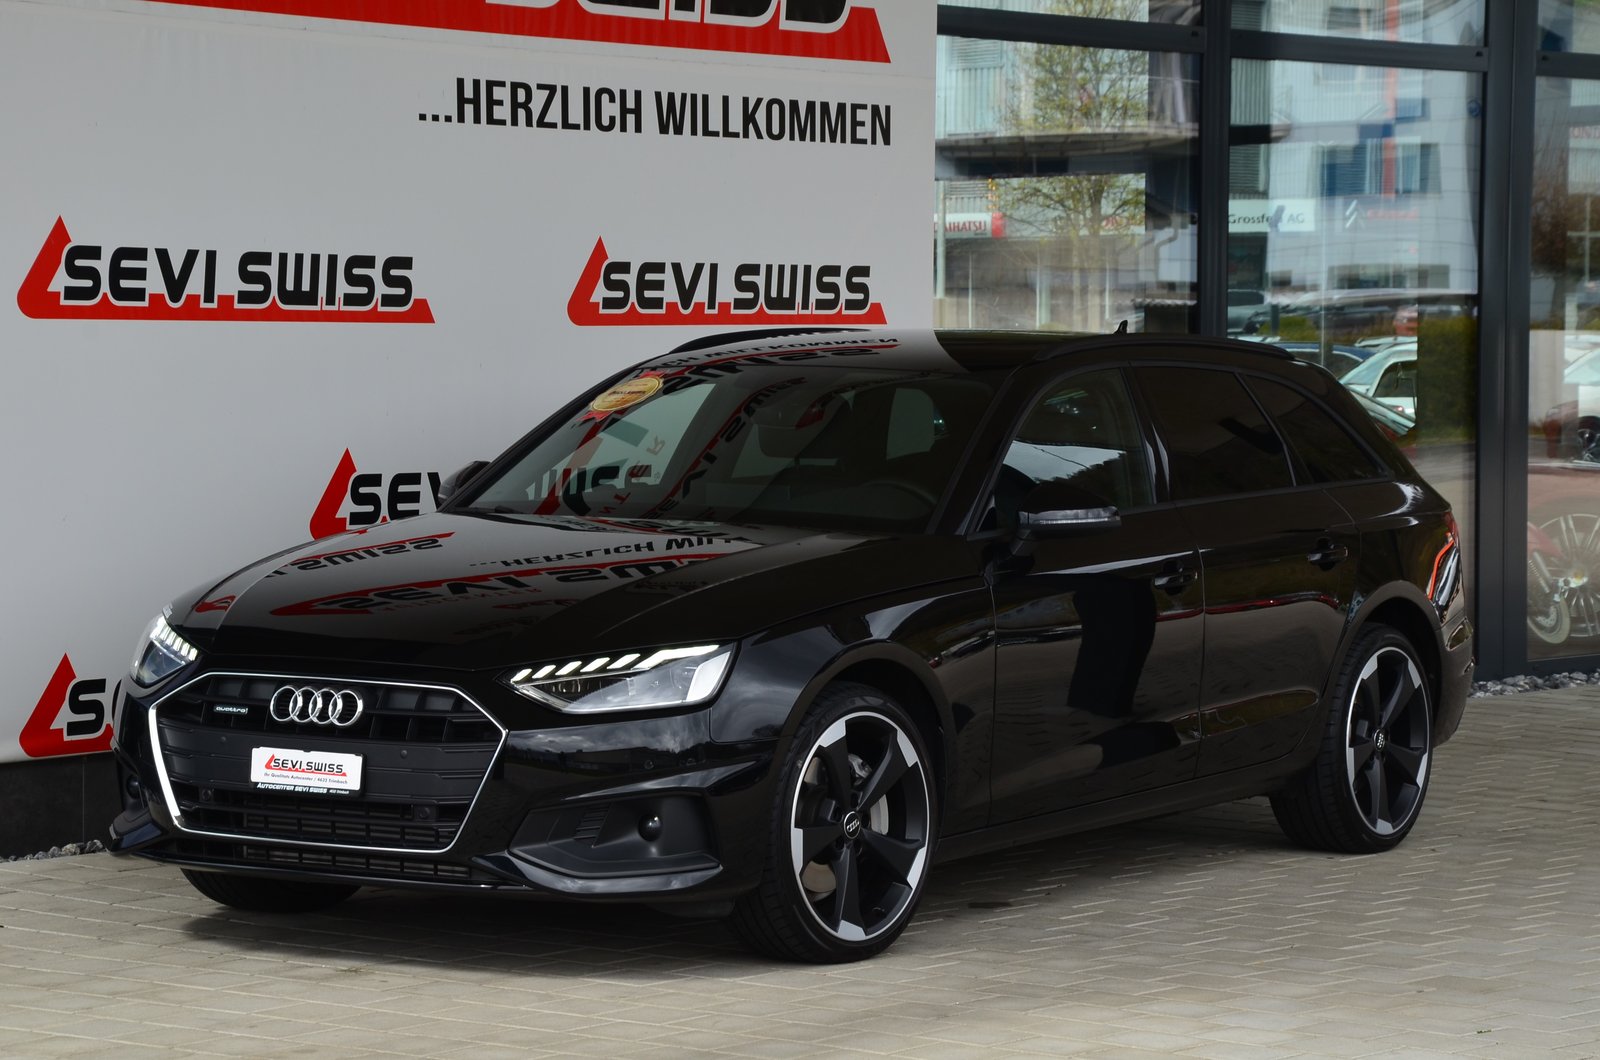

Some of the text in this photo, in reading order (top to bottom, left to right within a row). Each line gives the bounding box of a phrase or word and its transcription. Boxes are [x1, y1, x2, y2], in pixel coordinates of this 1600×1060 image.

[418, 77, 891, 146] ...HERZLICH WILLKOMMEN
[63, 244, 414, 308] SEVI SWISS
[601, 261, 871, 311] SEVI SWISS
[273, 758, 343, 774] SEVI SWISS
